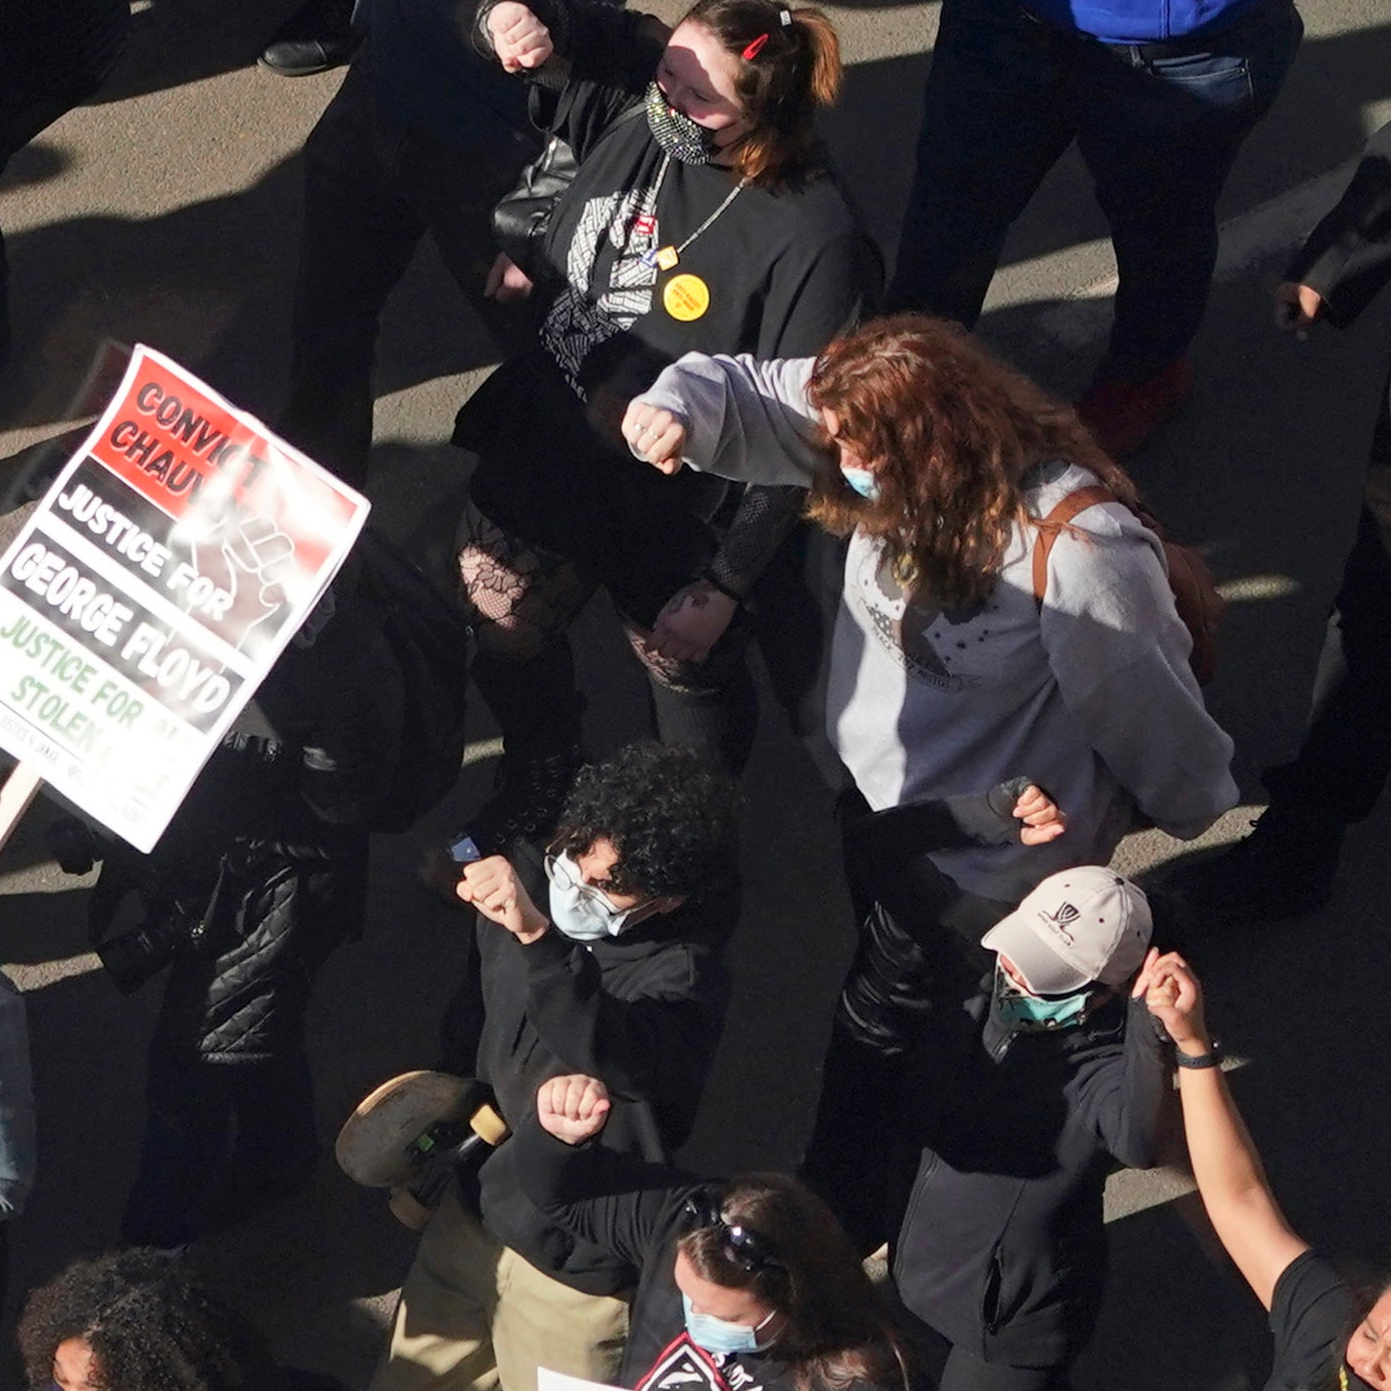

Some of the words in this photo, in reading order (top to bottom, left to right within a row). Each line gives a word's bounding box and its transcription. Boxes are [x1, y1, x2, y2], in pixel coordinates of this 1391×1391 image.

[136, 381, 271, 490] CONVICT
[58, 482, 173, 578] JUSTICE
[167, 566, 235, 621] FOR
[9, 542, 134, 648] GEORGE
[120, 622, 231, 717] FLOYD
[10, 674, 104, 754] STOLEN
[97, 682, 145, 730] FOR
